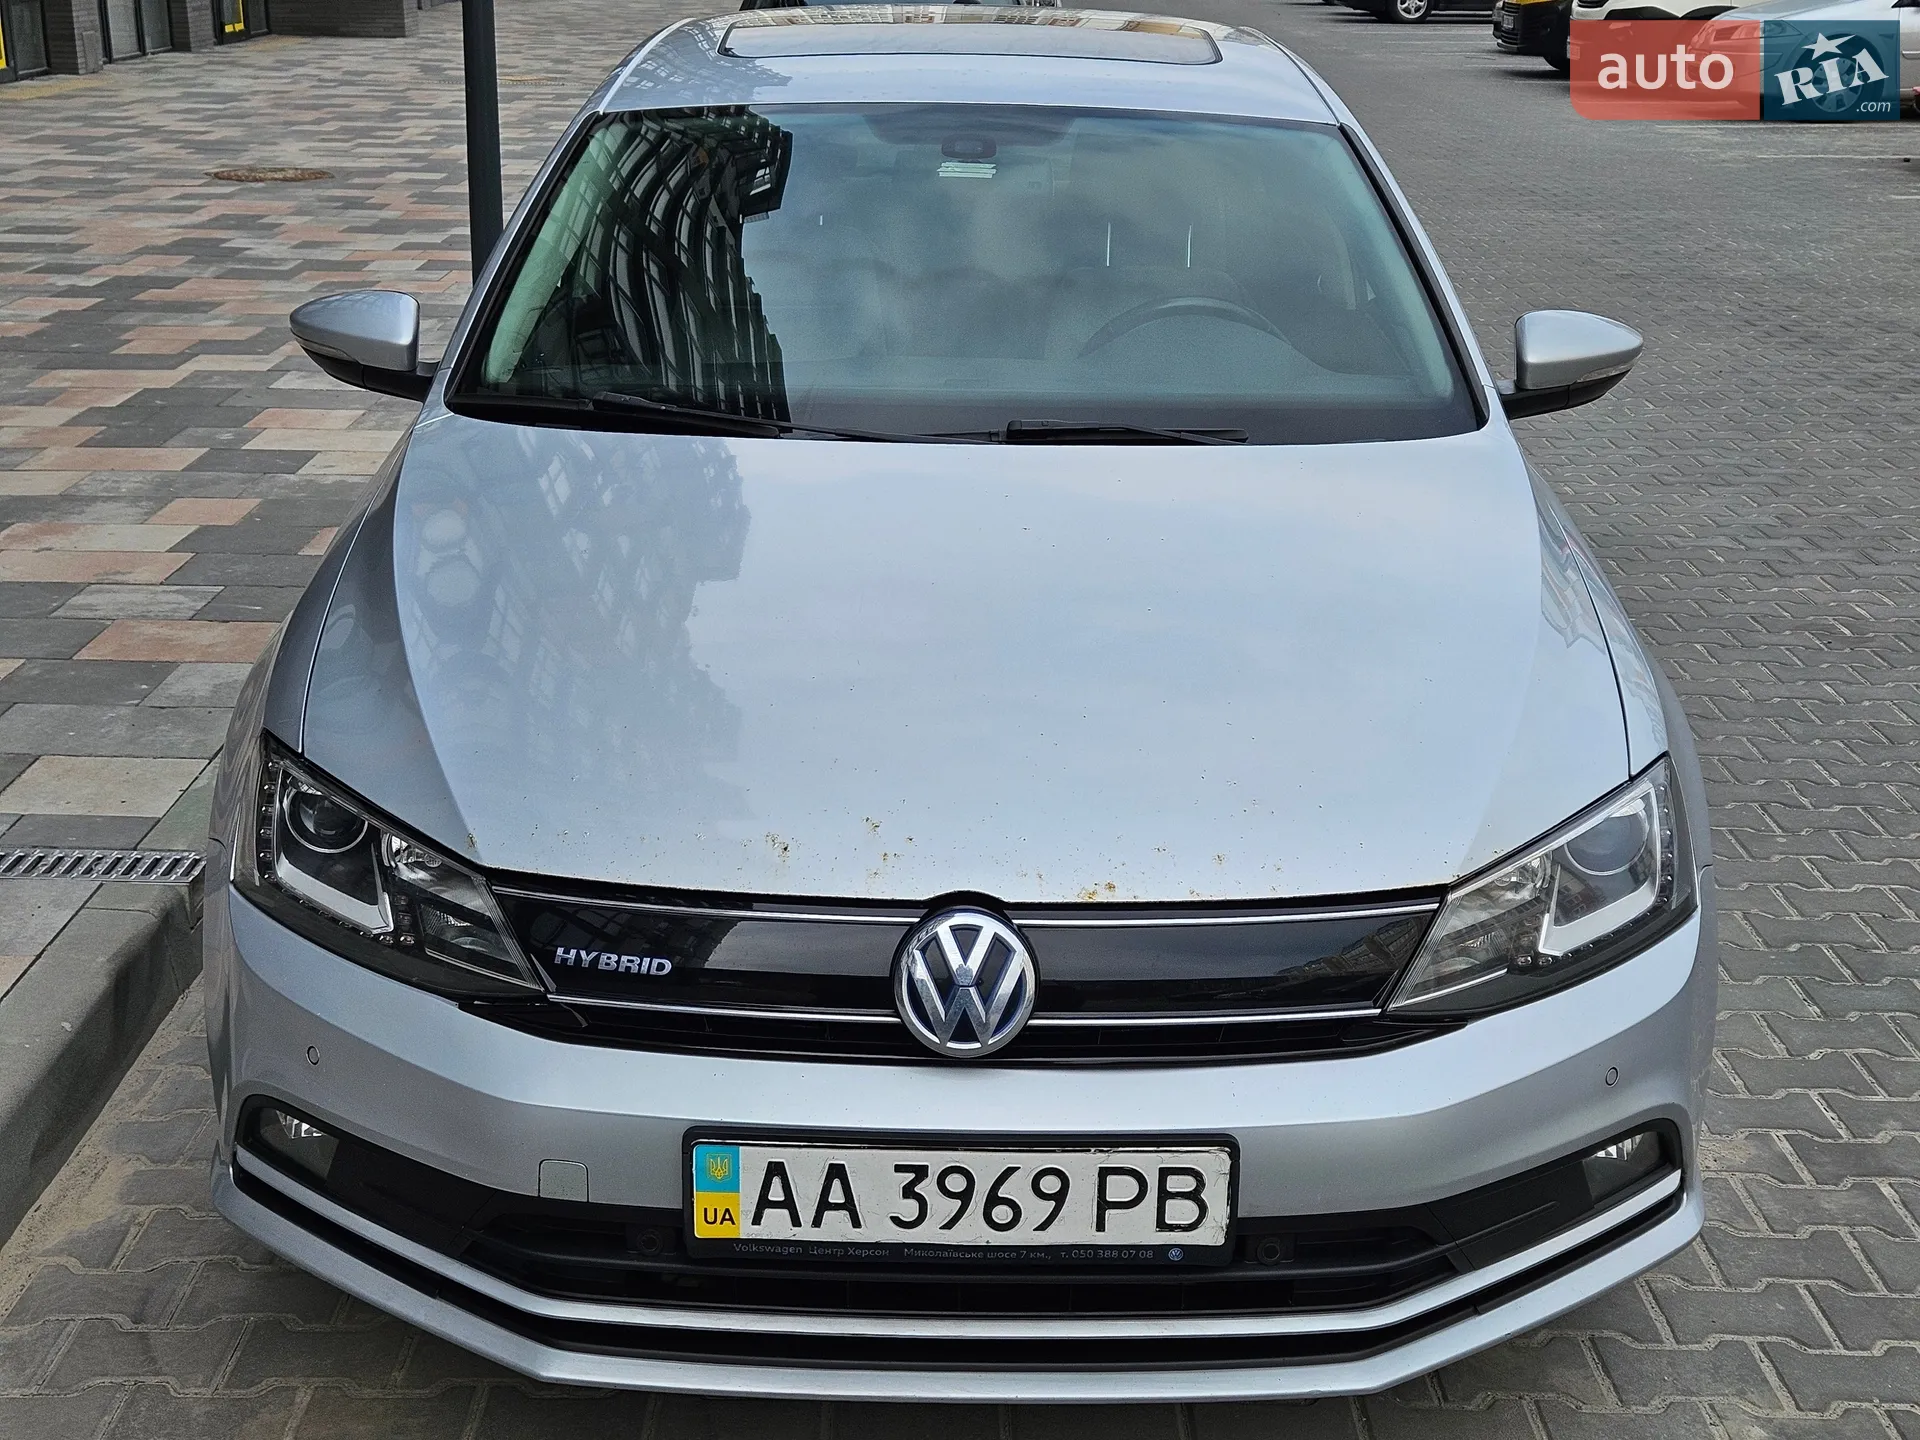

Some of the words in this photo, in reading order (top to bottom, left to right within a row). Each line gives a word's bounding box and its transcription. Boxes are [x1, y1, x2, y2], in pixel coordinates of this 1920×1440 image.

[553, 945, 674, 977] HYBRID
[751, 1160, 864, 1229] AA
[889, 1163, 1071, 1233] 3969
[1094, 1165, 1210, 1233] PB
[703, 1206, 737, 1226] UA
[733, 1243, 803, 1255] Volkswagen
[808, 1245, 845, 1257] Центр
[847, 1247, 890, 1258] Херсон
[903, 1247, 985, 1259] Миколаївське
[986, 1251, 1018, 1260] шосе
[1019, 1250, 1027, 1259] 7
[1071, 1250, 1094, 1259] 050
[1096, 1250, 1119, 1259] 388
[1120, 1250, 1137, 1259] 07
[1139, 1250, 1155, 1259] 08
